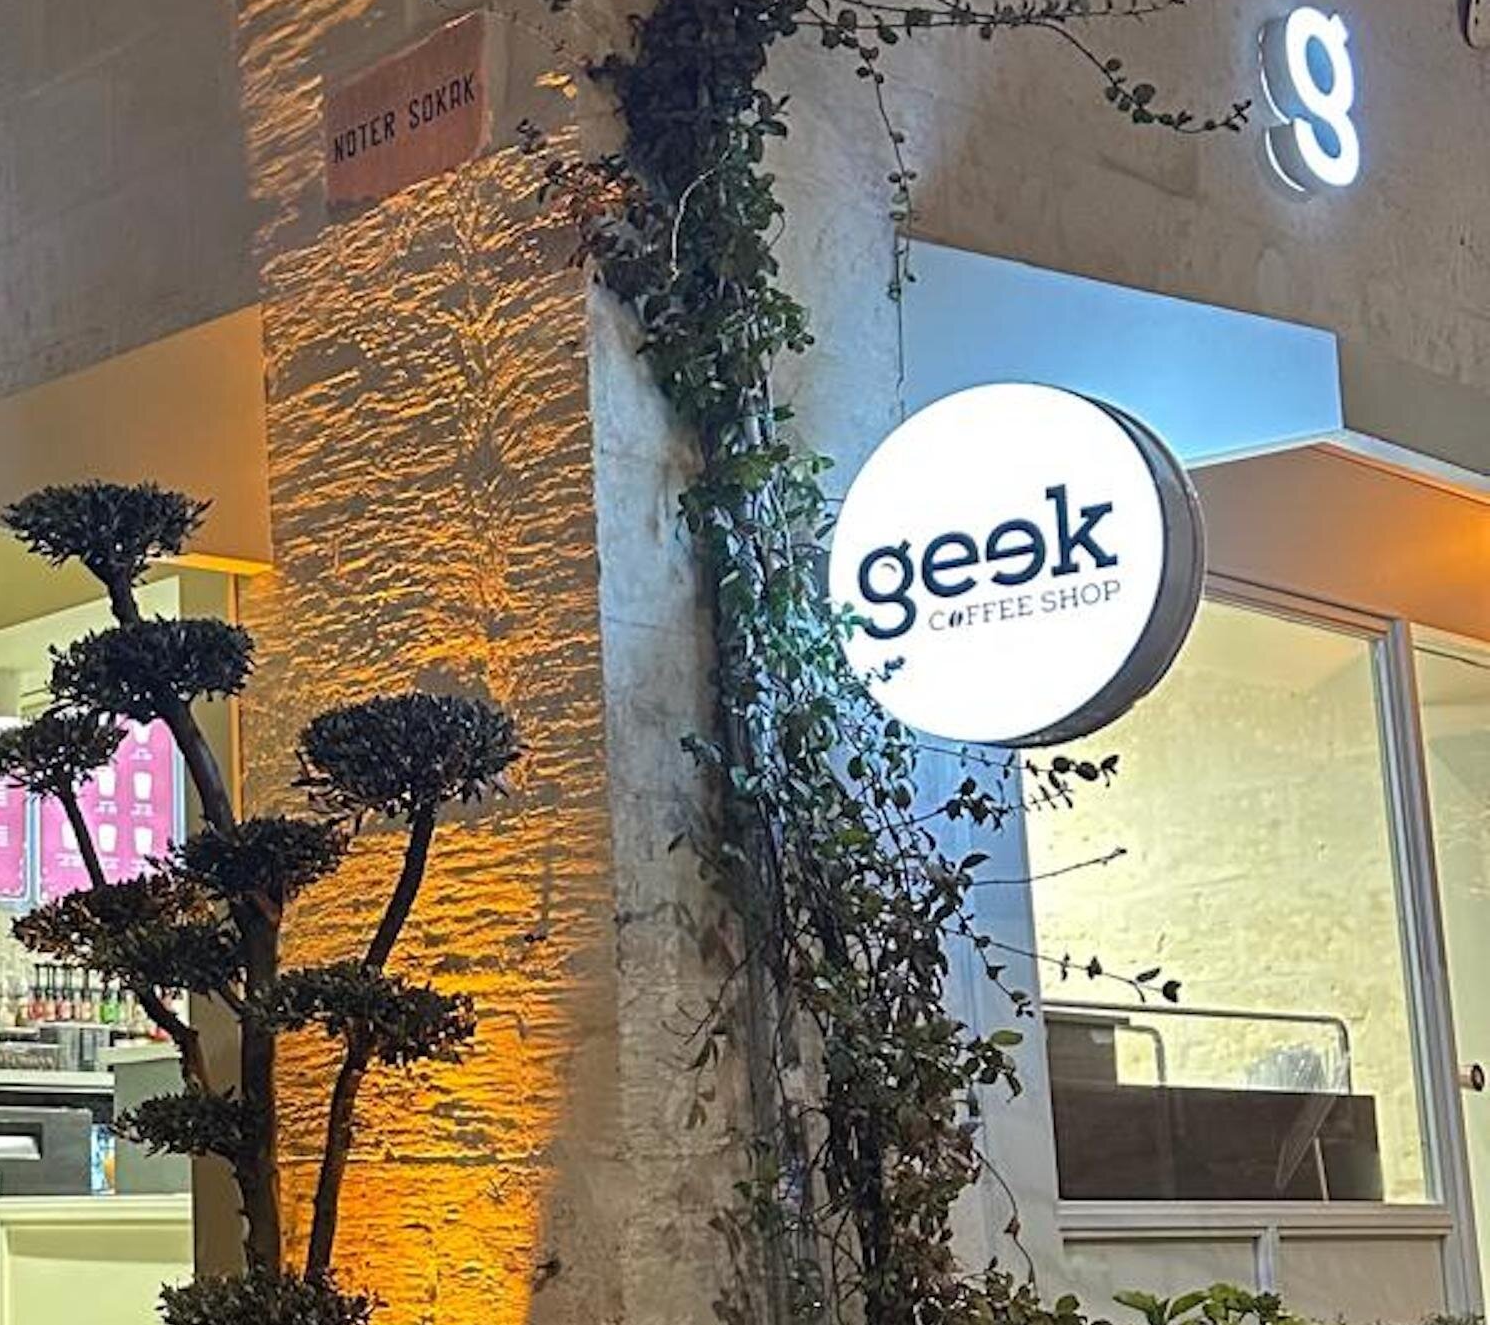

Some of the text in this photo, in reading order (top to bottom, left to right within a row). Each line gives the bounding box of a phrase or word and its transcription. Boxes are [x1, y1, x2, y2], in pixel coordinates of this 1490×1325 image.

[333, 72, 476, 164] NOTER SOKAK
[1285, 6, 1359, 187] g
[857, 483, 1119, 641] geek
[928, 579, 1121, 631] COFFEE SHOP
